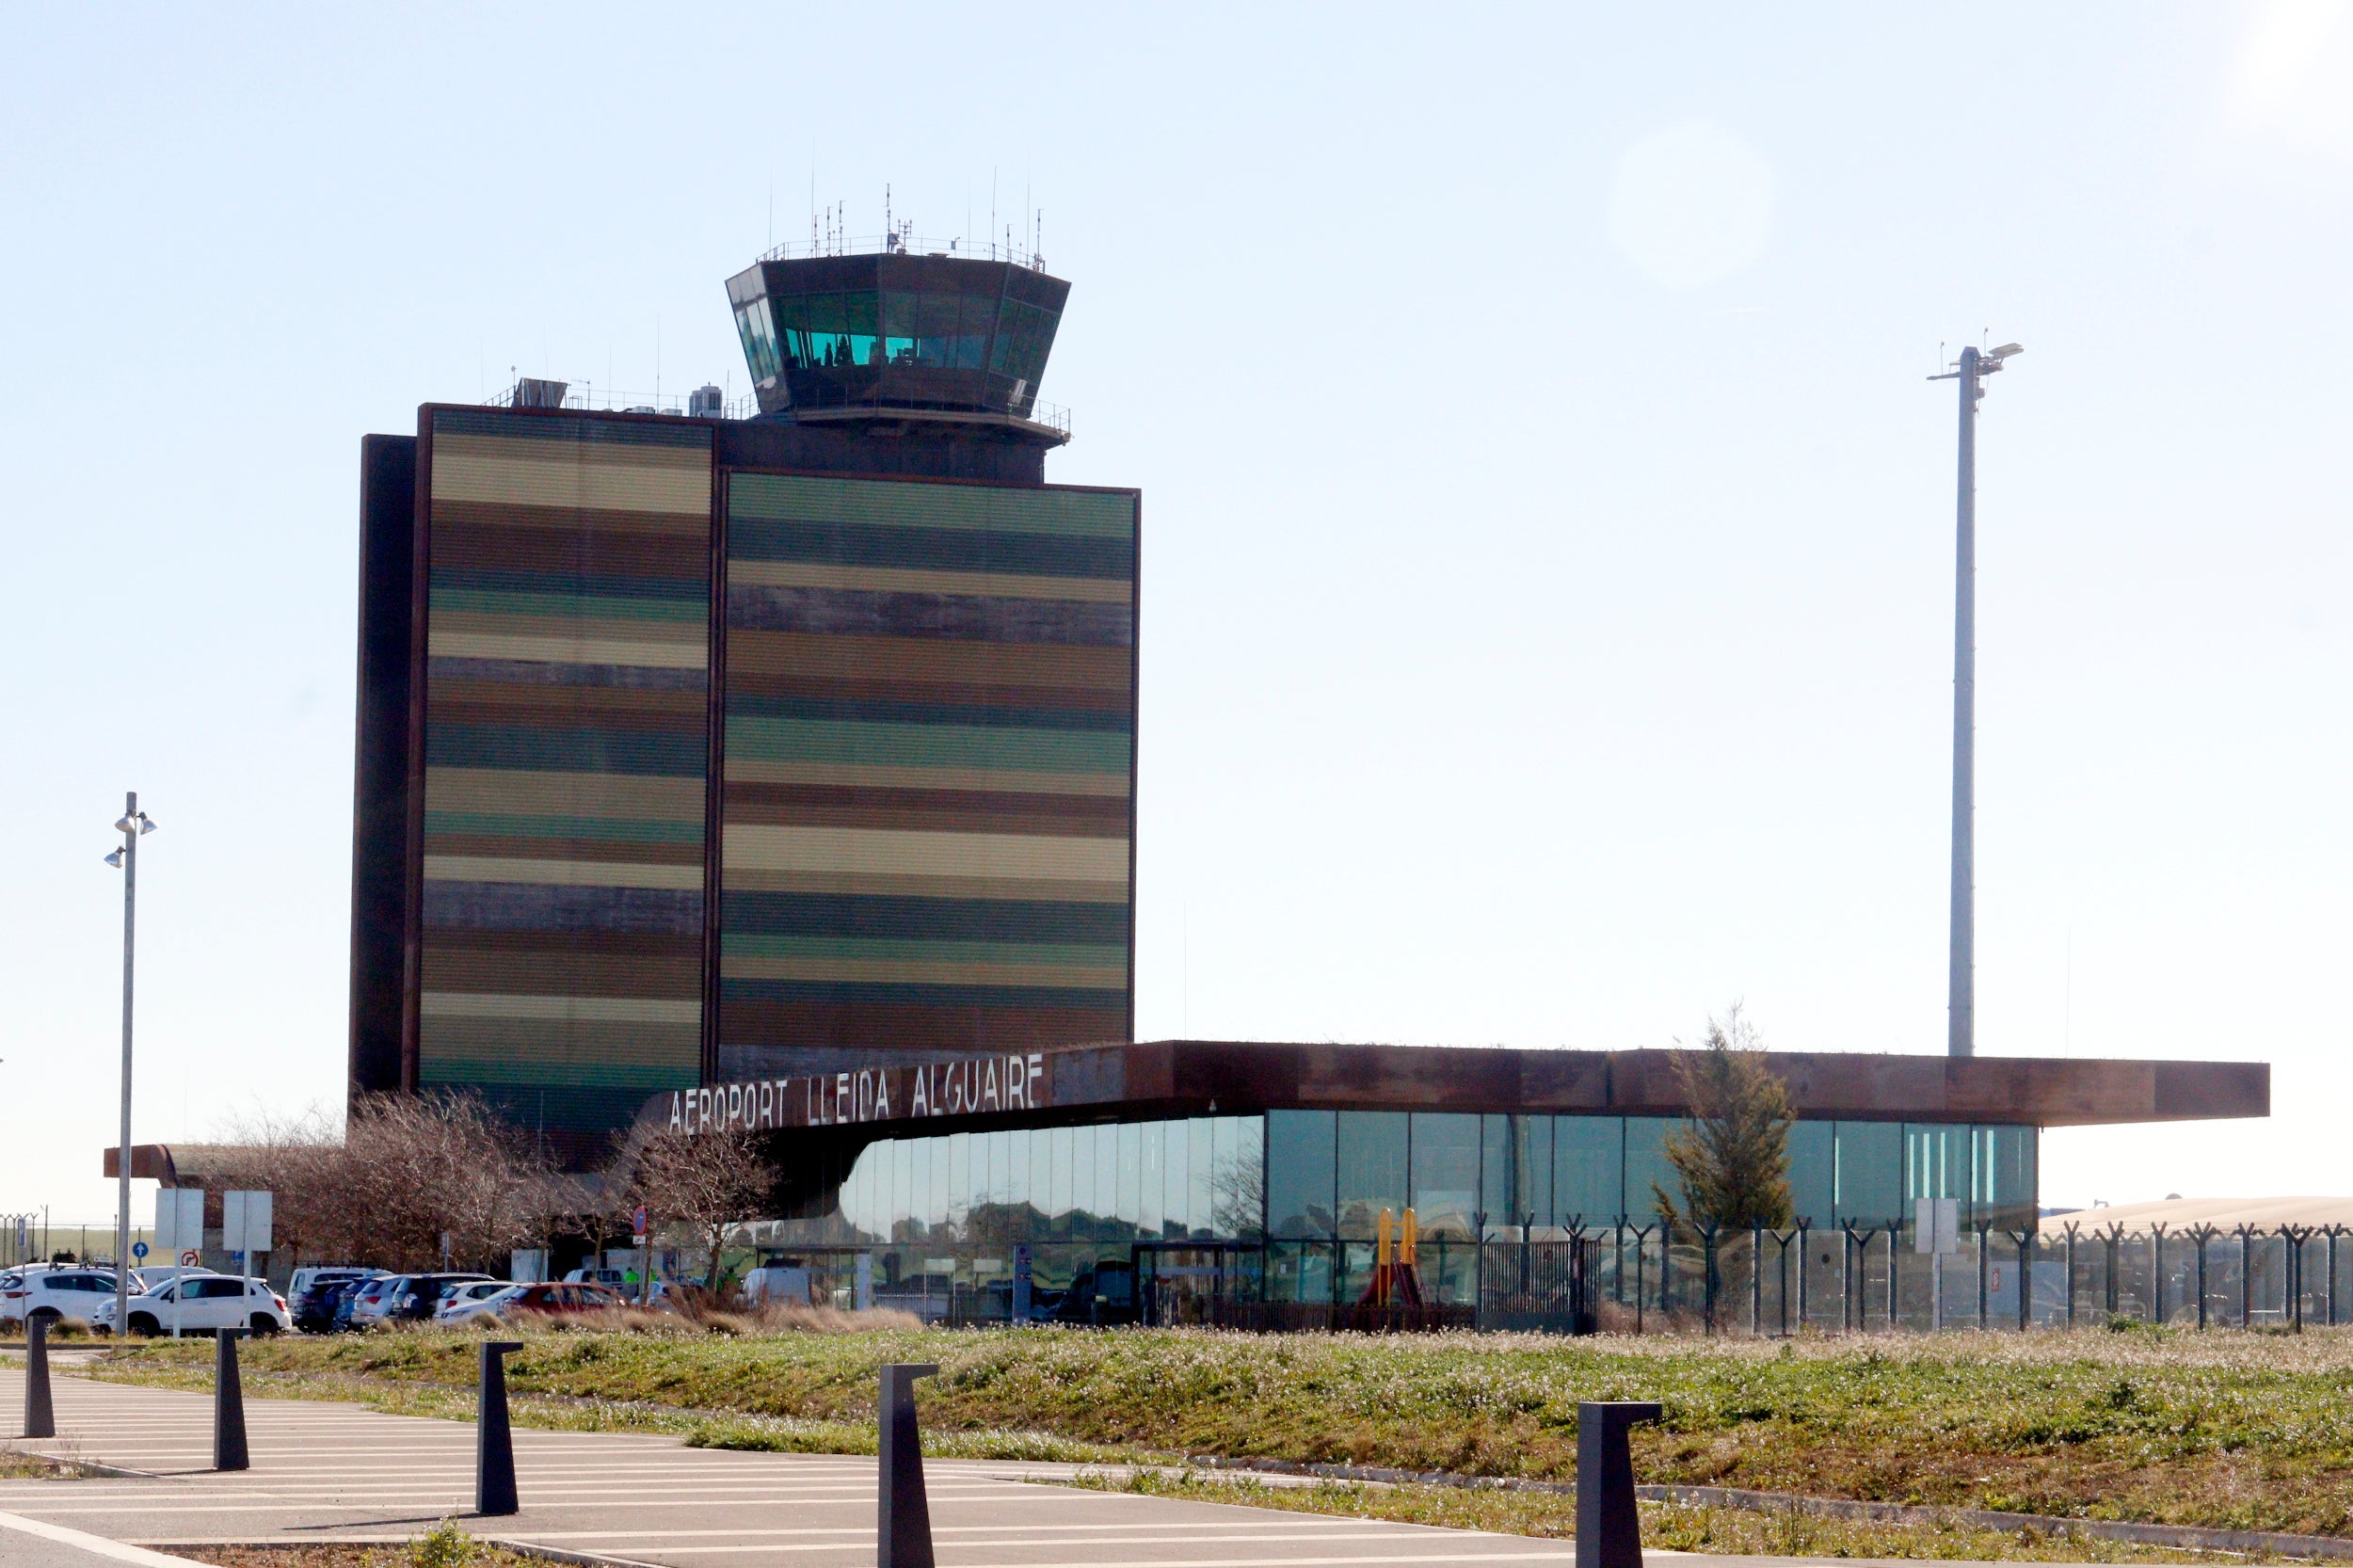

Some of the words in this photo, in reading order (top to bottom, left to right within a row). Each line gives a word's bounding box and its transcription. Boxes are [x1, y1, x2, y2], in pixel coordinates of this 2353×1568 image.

[669, 1080, 788, 1135] AEROPORT
[808, 1069, 889, 1126] LLEIDA
[911, 1053, 1043, 1118] ALGUAIRE
